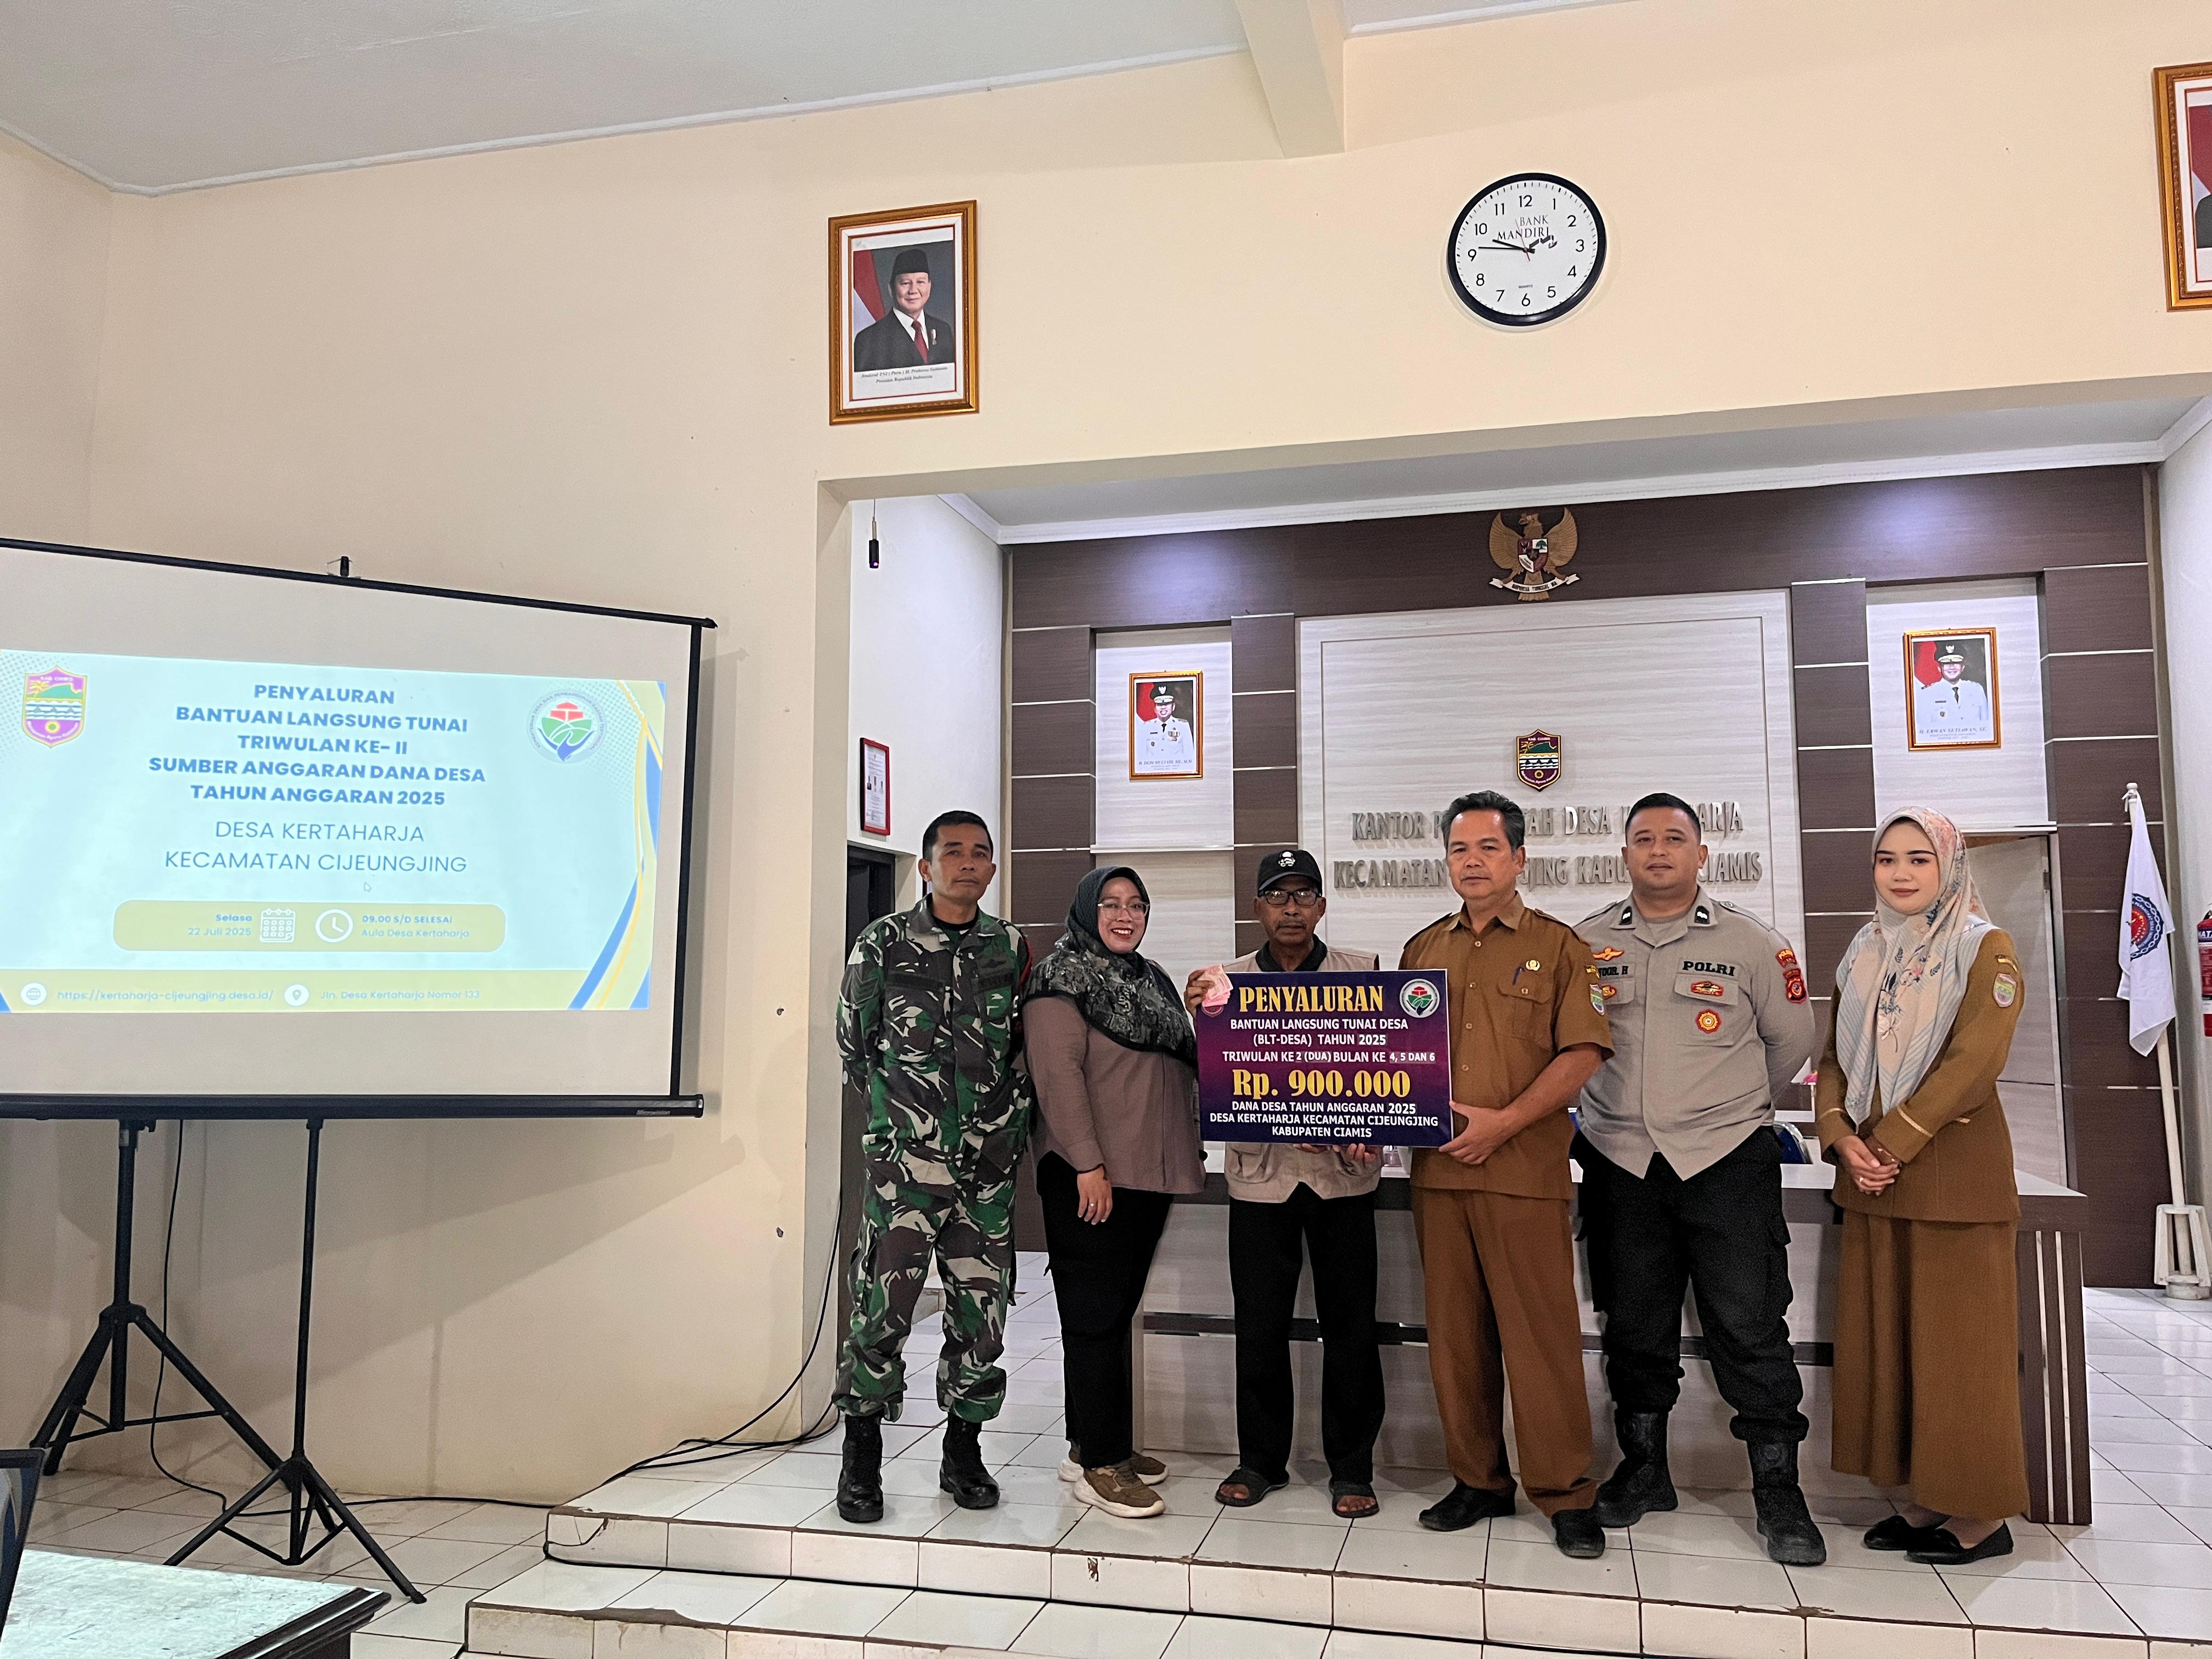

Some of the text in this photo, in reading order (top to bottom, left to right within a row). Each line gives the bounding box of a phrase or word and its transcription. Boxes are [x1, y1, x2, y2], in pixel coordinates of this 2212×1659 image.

[1519, 195, 1532, 207] 12
[1552, 198, 1556, 210] 1
[1494, 203, 1505, 216] 11
[1520, 215, 1549, 226] BANK
[1567, 215, 1576, 227] 2
[1474, 223, 1487, 235] 10
[1497, 227, 1549, 240] MANDIRI
[1576, 239, 1584, 252] 3
[1468, 249, 1477, 262] 9
[1567, 265, 1577, 277] 4
[1476, 273, 1485, 286] 8
[1496, 290, 1505, 302] 7
[1547, 286, 1556, 298] 5
[1521, 293, 1531, 306] 6
[254, 685, 394, 704] PENYALURAN
[176, 706, 468, 732] BANTUAN LANGSUNG TUNAI
[238, 735, 408, 755] TRIWULAN KE- II
[149, 757, 486, 782] SUMBER ANGGARAN DANA DESA
[190, 785, 445, 805] TAHUN ANGGARAN 2025
[1352, 811, 1425, 840] KANTOR
[1564, 805, 1612, 835] DESA
[215, 821, 425, 842] DESA KERTAHARJA
[165, 851, 467, 872] KECAMATAN CIJEUNGJING
[1333, 859, 1447, 888] KECAMATAN
[215, 913, 253, 922] Selasa
[362, 915, 453, 925] 09.00 S/D SELESAI
[188, 927, 252, 936] 22 Juli 2025
[361, 928, 470, 940] Aula Desa Kertaharja
[1621, 966, 1629, 975] H
[1682, 960, 1736, 977] POLRI
[57, 989, 274, 1002] https://kertaharja-cijeungjing.desa.id/
[341, 991, 367, 1000] Desa
[370, 991, 425, 1001] Kertaharja
[427, 991, 462, 999] Nomor
[465, 990, 481, 999] 133
[1239, 985, 1384, 1013] PENYALURAN
[1231, 1019, 1408, 1030] BANTUAN LANGSUNG TUNAI DESA
[1253, 1034, 1386, 1047] (BLT-DESA) TAHUN 2025
[1222, 1051, 1435, 1063] TRIWULAN KE 2 (DUA) BULAN KE 4, 5 DAN 6
[1232, 1069, 1411, 1100] Rp. 900.000
[1232, 1102, 1416, 1114] DANA DESA TAHUN ANGGARAN 2025
[1210, 1113, 1438, 1126] DESA KERTAHARJA KECAMATAN CIJEUNGJING
[1272, 1126, 1372, 1138] KABUPATEN CIAMIS
